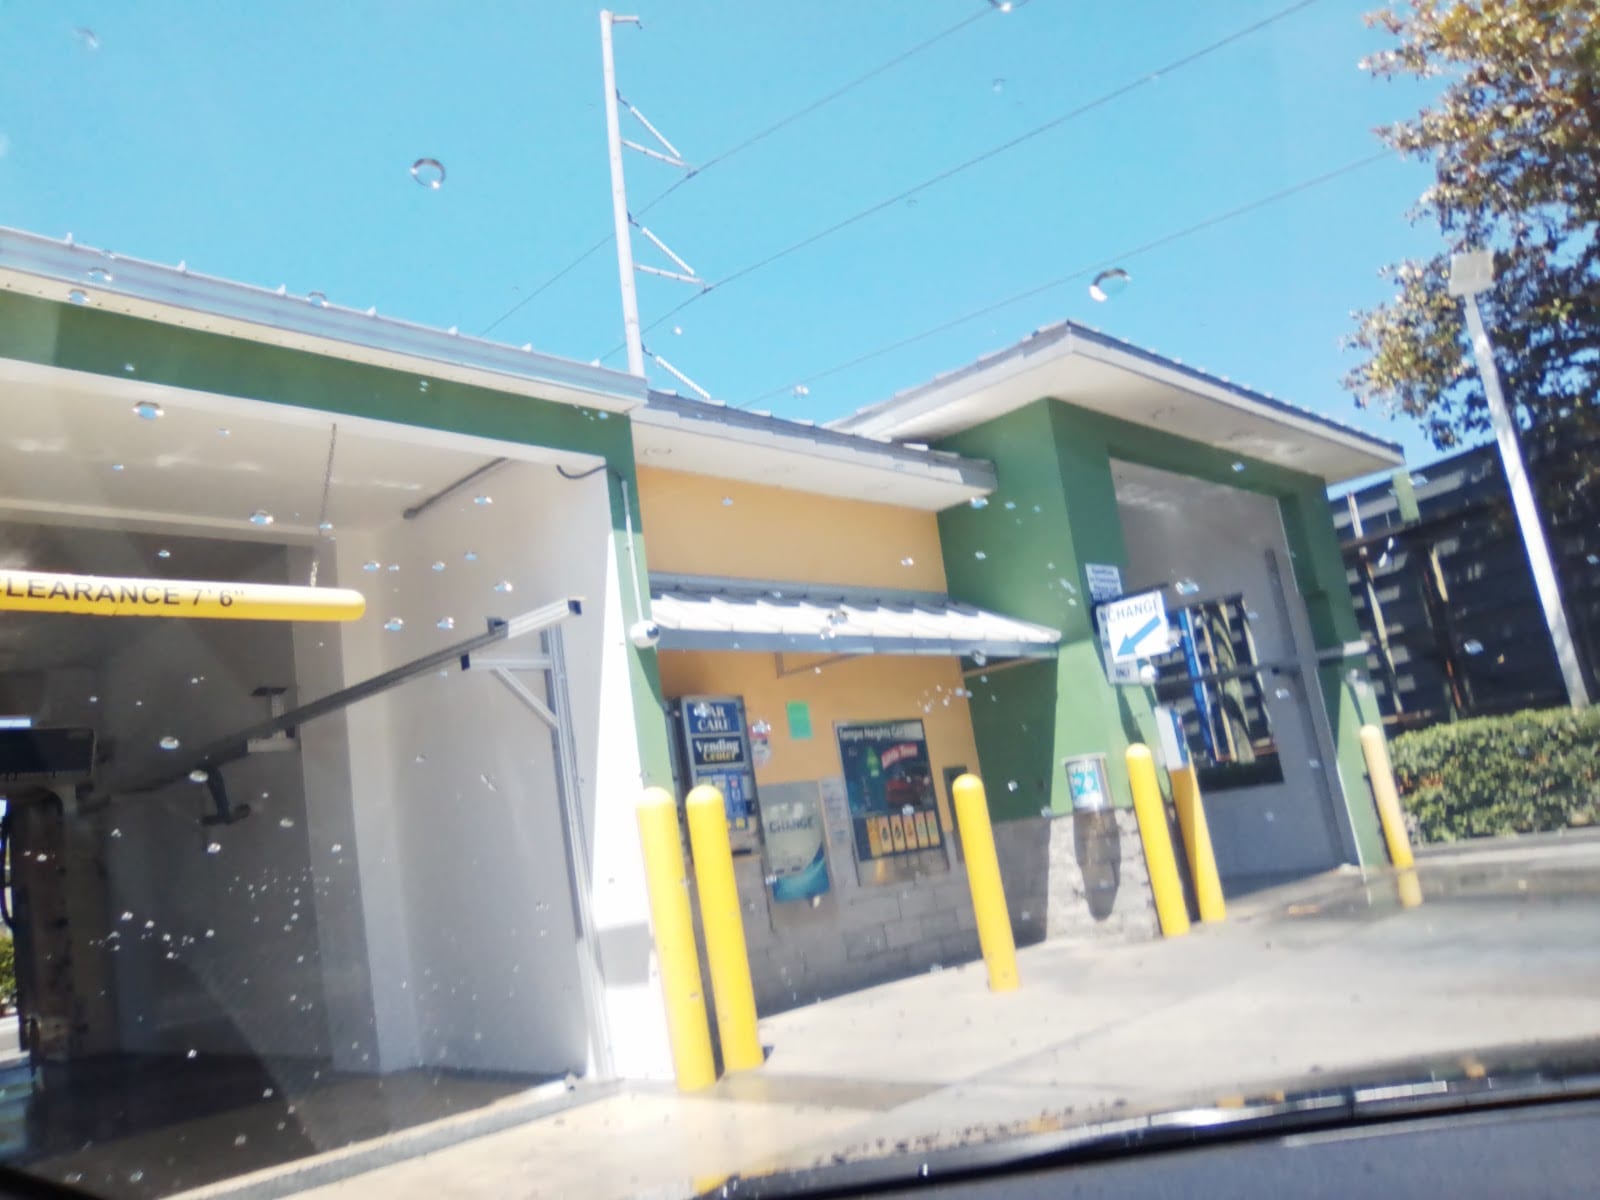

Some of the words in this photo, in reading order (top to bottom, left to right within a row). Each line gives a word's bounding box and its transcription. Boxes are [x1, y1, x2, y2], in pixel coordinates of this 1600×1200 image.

[0, 577, 180, 606] LEARANCE
[191, 587, 214, 606] 7'
[1108, 598, 1161, 622] CHANGE
[698, 704, 726, 717] AR
[696, 738, 740, 754] Vending
[703, 750, 738, 763] Center
